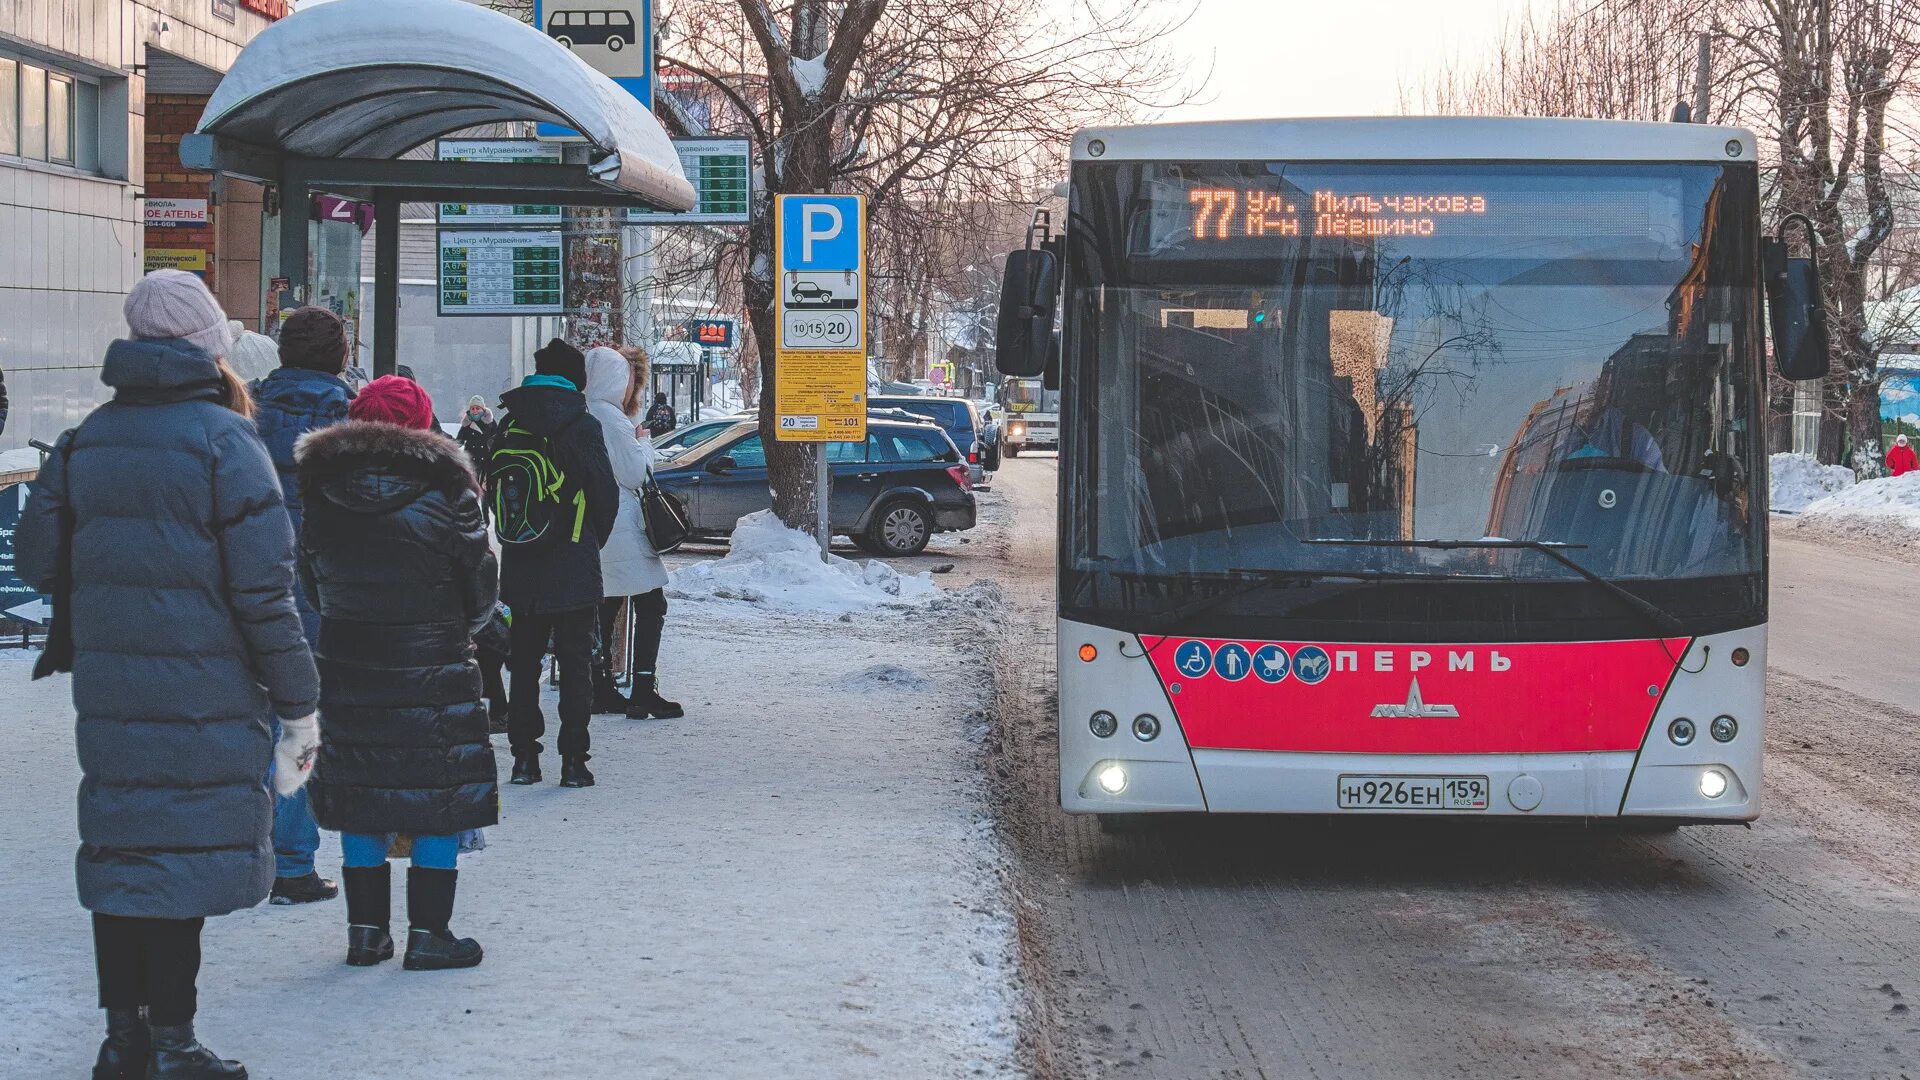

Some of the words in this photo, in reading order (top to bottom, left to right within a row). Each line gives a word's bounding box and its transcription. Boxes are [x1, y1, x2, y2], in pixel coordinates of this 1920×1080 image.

[453, 147, 476, 155] Центр
[478, 146, 533, 155] «Муравейник»
[675, 145, 719, 154] уравейник»
[1247, 191, 1296, 213] Ул.
[1315, 191, 1486, 213] Мильчакова
[164, 210, 204, 219] АТЕЛЬЕ
[1191, 191, 1235, 238] 77
[1247, 214, 1299, 236] М-н
[1315, 213, 1434, 236] Лёвшино
[453, 237, 476, 245] Центр
[478, 236, 533, 245] «Муравейник»
[793, 324, 805, 333] 10
[808, 323, 822, 334] 15
[828, 322, 845, 335] 20
[782, 417, 795, 427] 20
[843, 417, 859, 427] 101
[1335, 650, 1512, 672] ПЕРМЬ
[1348, 781, 1440, 805] Н926ЕН
[1446, 780, 1481, 799] 159
